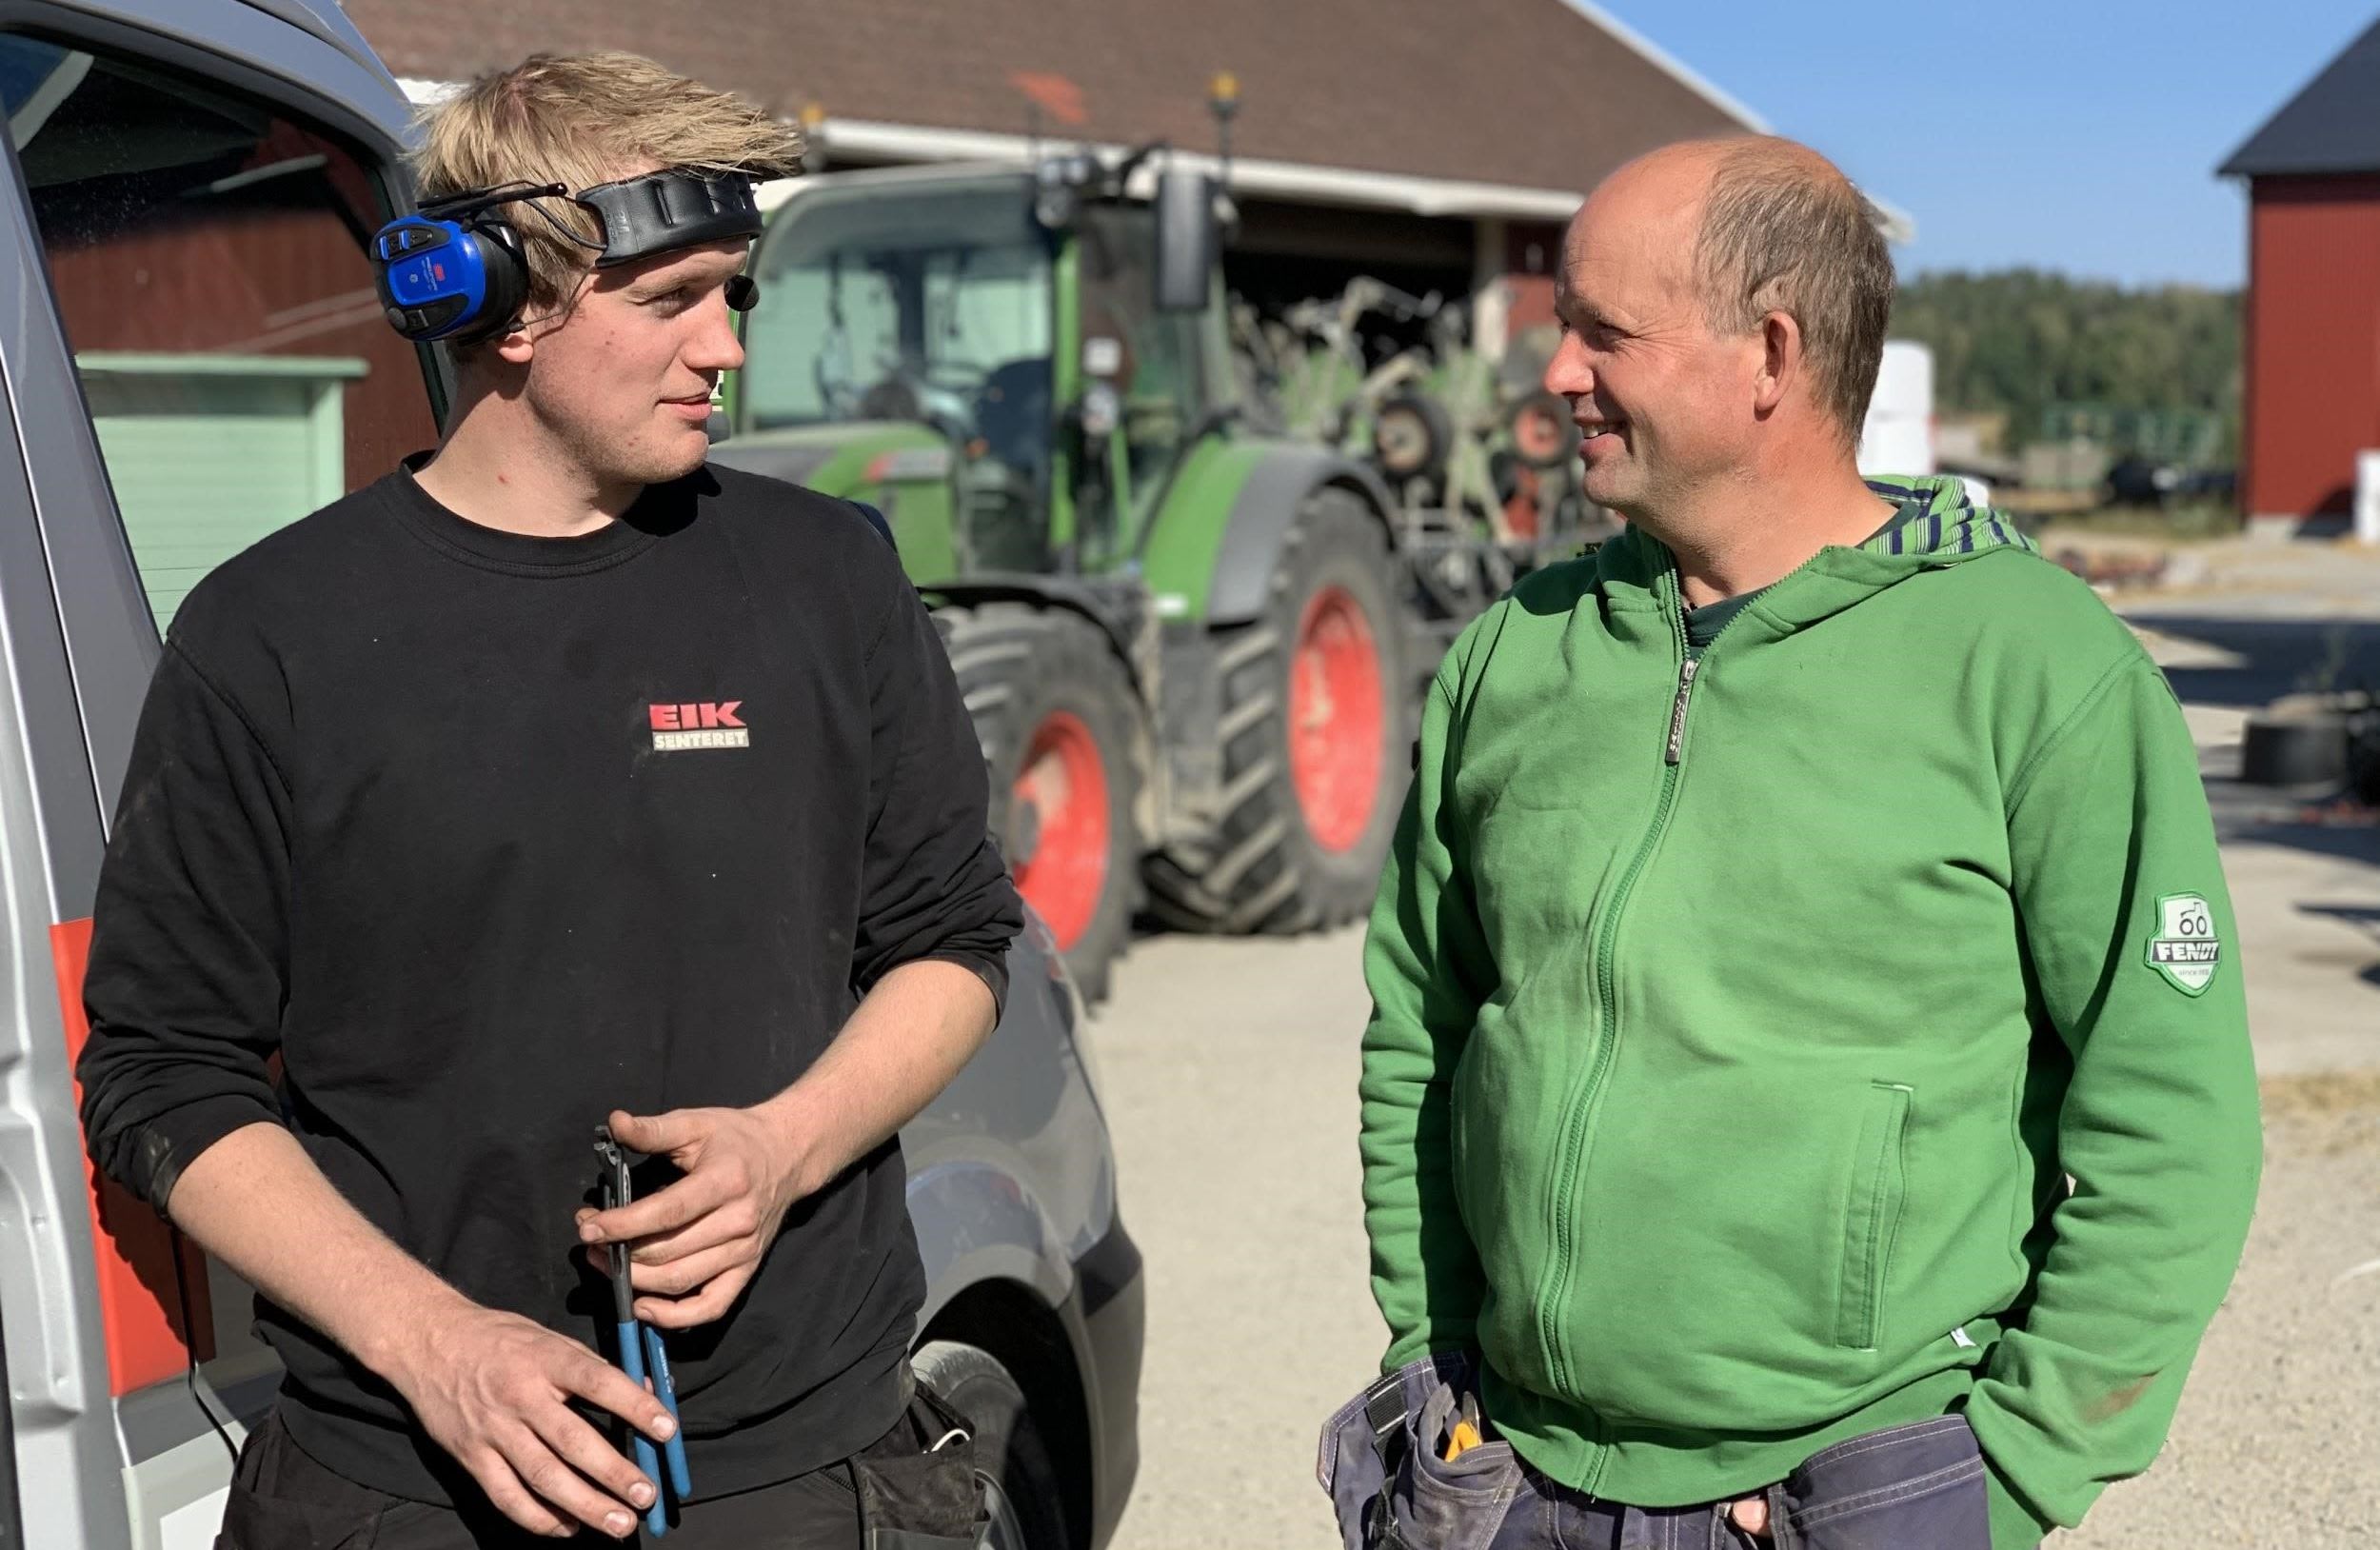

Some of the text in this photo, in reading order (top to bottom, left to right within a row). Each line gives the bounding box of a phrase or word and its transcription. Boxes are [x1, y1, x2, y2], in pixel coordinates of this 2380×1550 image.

[649, 701, 747, 730] EIK
[653, 729, 748, 749] SENTERET
[2155, 942, 2219, 961] FENDT
